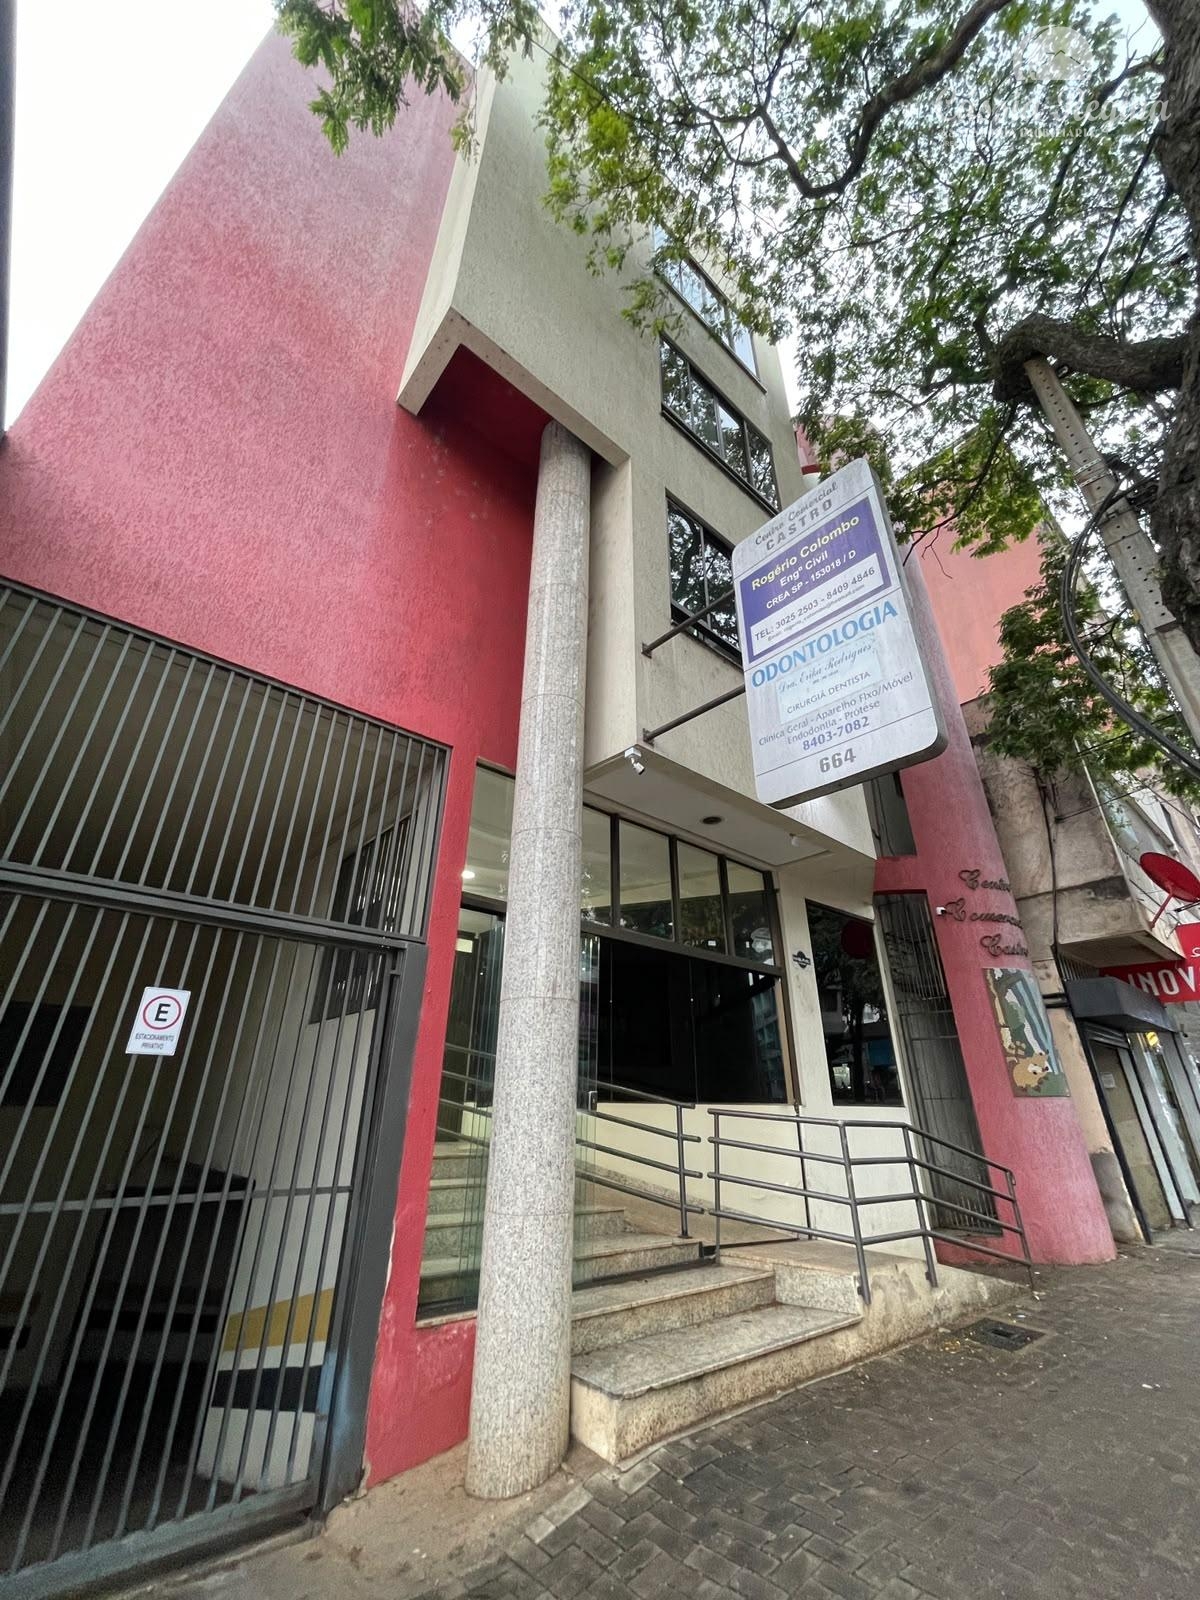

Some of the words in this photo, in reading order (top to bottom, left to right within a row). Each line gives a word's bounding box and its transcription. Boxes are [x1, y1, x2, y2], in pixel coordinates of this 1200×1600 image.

[766, 499, 832, 550] CASTRO
[751, 556, 798, 591] Rogério
[799, 516, 860, 558] Colombo
[805, 550, 828, 570] Civil
[766, 590, 790, 609] CREA
[791, 584, 804, 594] SP
[810, 559, 841, 582] 153018
[848, 549, 857, 560] D
[775, 613, 796, 629] 3025
[797, 599, 819, 617] 2503
[826, 582, 849, 600] 8409
[851, 566, 875, 585] 4846
[751, 600, 898, 688] ODONTOLOGIA
[828, 671, 871, 696] DENTISTA
[786, 716, 809, 734] Geral
[815, 696, 857, 724] Aparelho
[787, 718, 838, 745] Endodontia
[844, 699, 881, 721] Prótese
[802, 716, 870, 752] 8403-7082
[819, 747, 857, 773] 664
[154, 1003, 171, 1022] E
